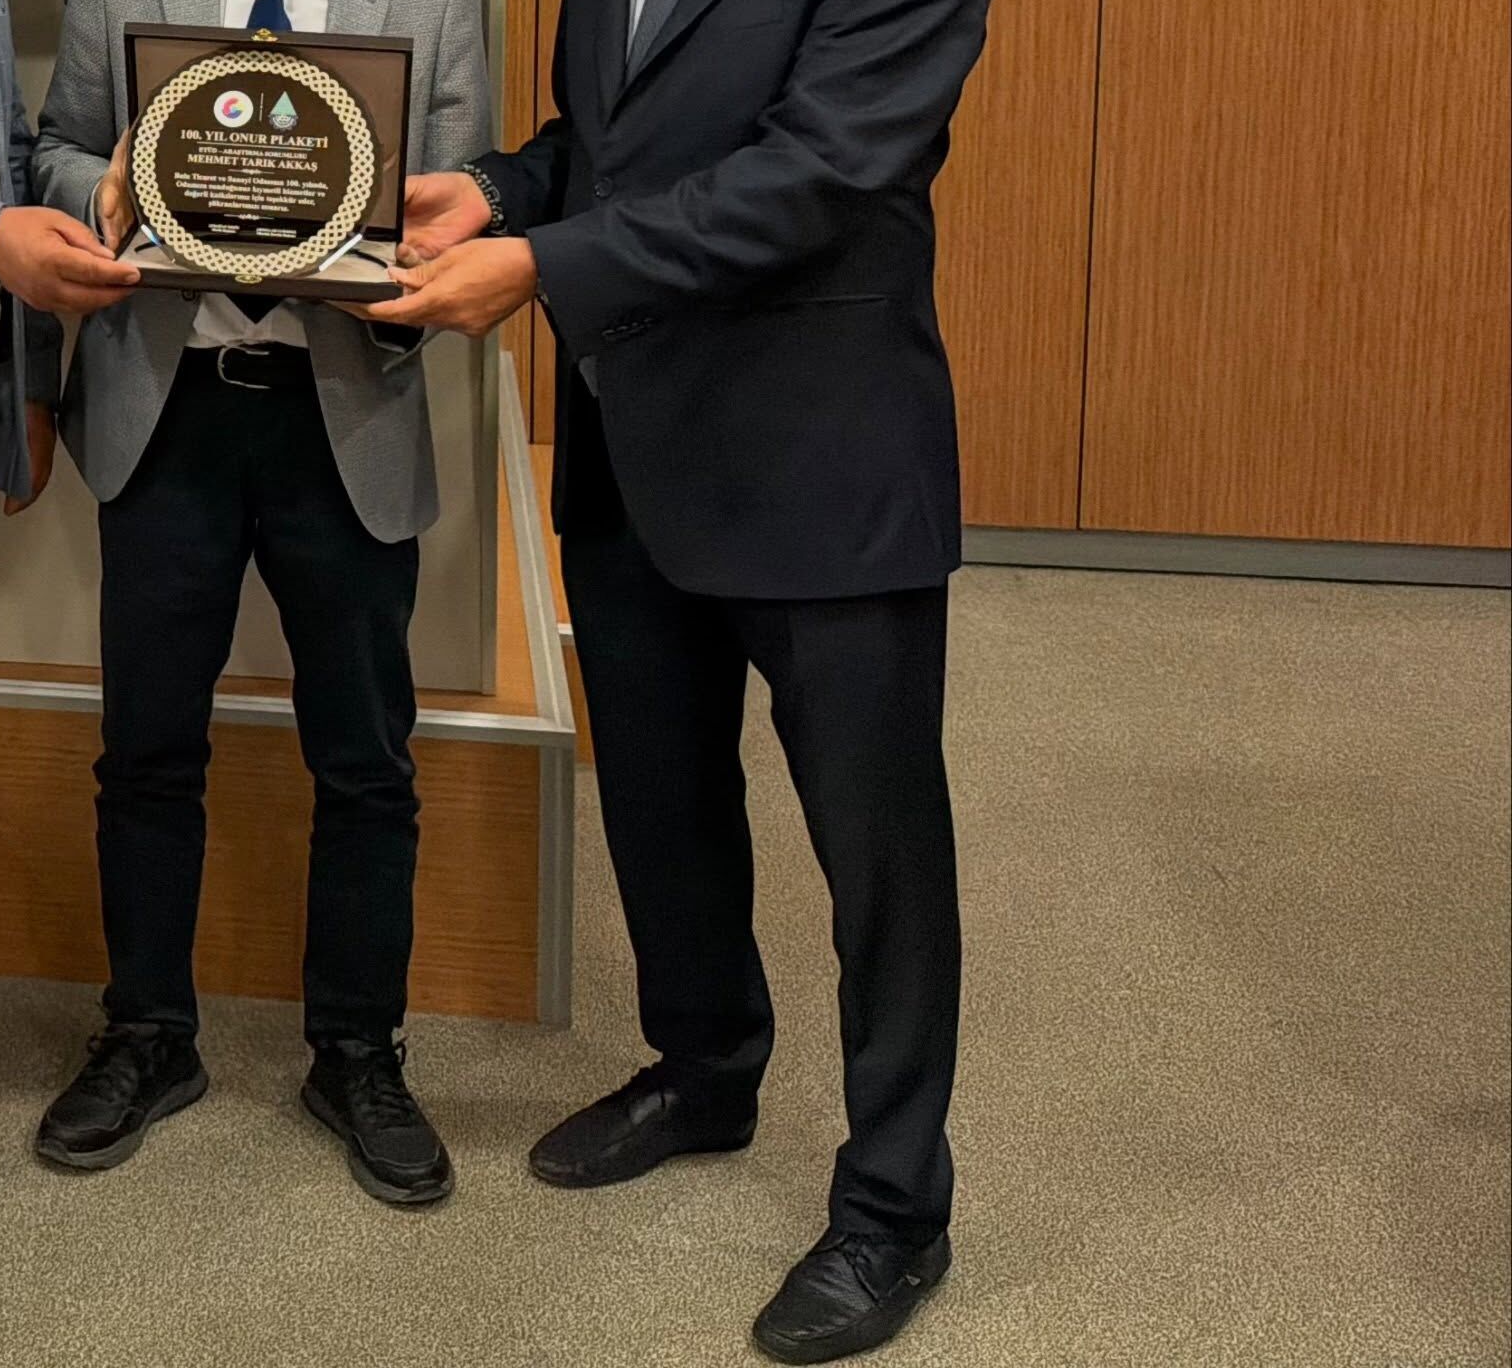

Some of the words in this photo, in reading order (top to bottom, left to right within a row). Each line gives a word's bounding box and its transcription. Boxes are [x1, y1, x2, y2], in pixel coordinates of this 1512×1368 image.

[180, 129, 202, 140] 100.
[205, 130, 227, 142] YIL
[229, 132, 267, 145] ONUR
[270, 134, 328, 148] PLAKETİ
[187, 154, 239, 166] MEHMET
[240, 157, 276, 168] TARIK
[278, 160, 318, 173] AKKAŞ
